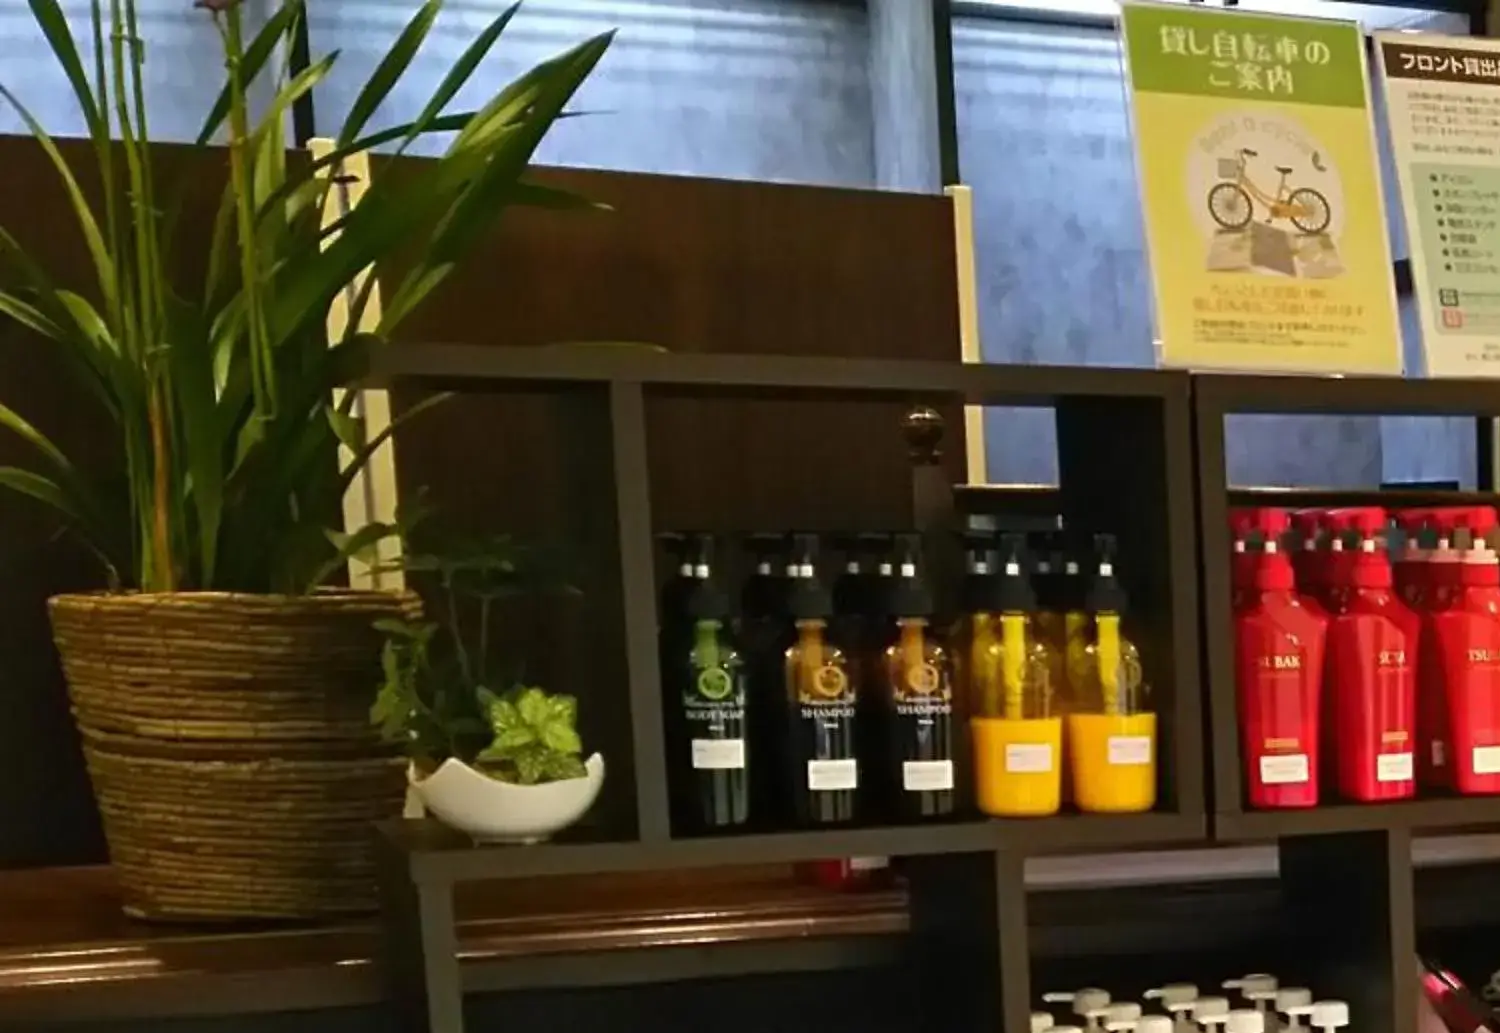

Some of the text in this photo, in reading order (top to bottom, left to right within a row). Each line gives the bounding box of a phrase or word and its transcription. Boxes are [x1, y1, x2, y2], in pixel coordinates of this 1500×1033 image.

[1159, 24, 1332, 65] 貸し自転車の
[1207, 59, 1295, 95] ご案内
